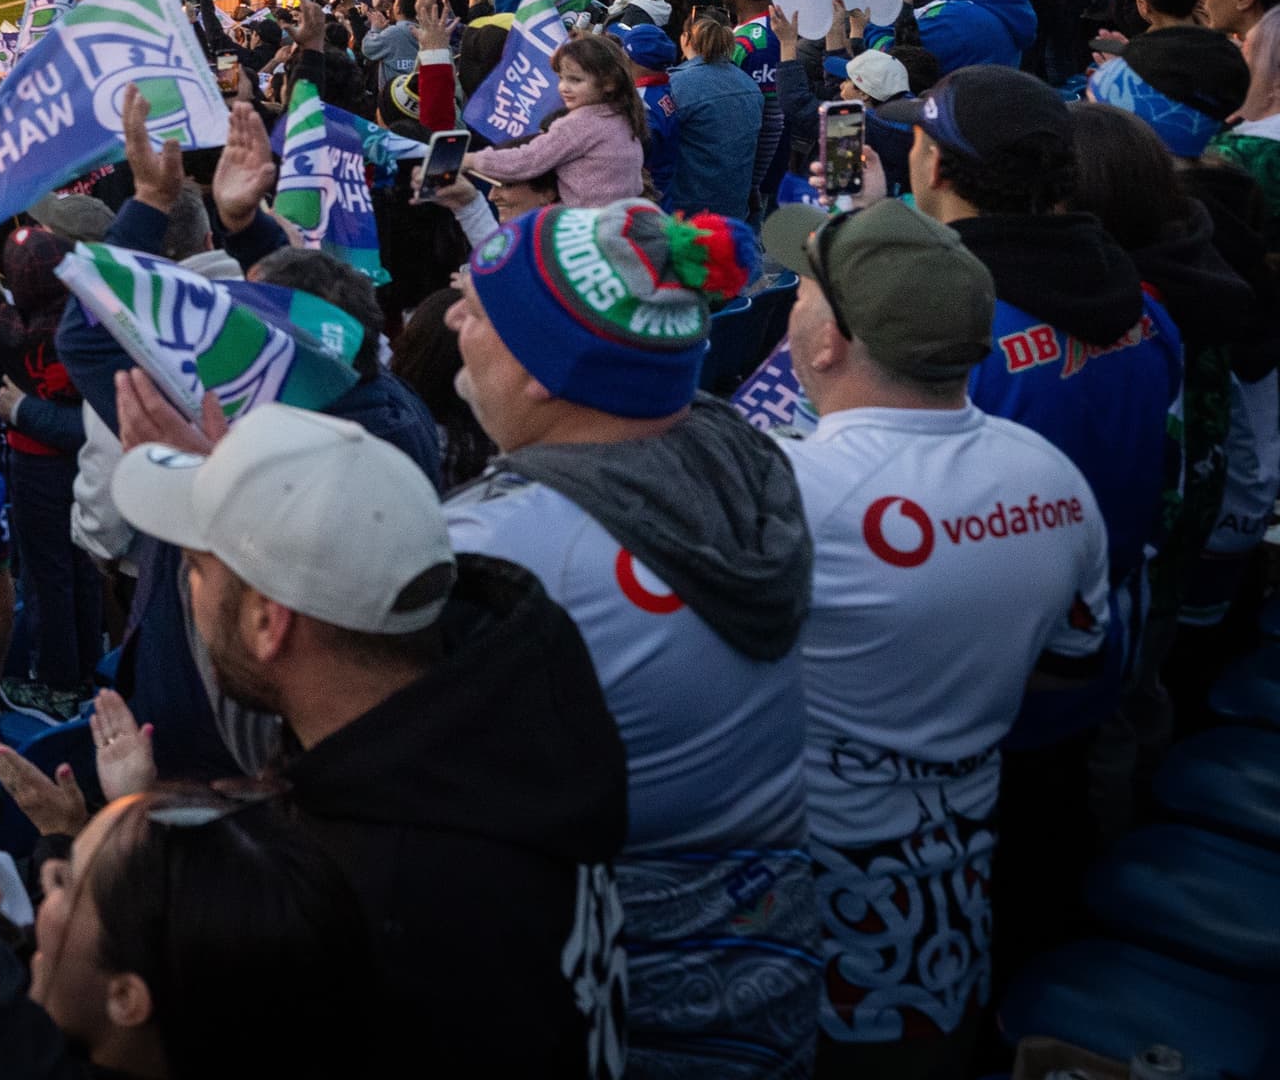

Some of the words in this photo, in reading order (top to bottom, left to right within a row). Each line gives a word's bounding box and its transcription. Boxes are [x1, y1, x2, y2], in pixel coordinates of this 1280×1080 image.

[752, 64, 777, 83] sk
[999, 325, 1060, 374] DB
[942, 495, 1084, 545] vodafone
